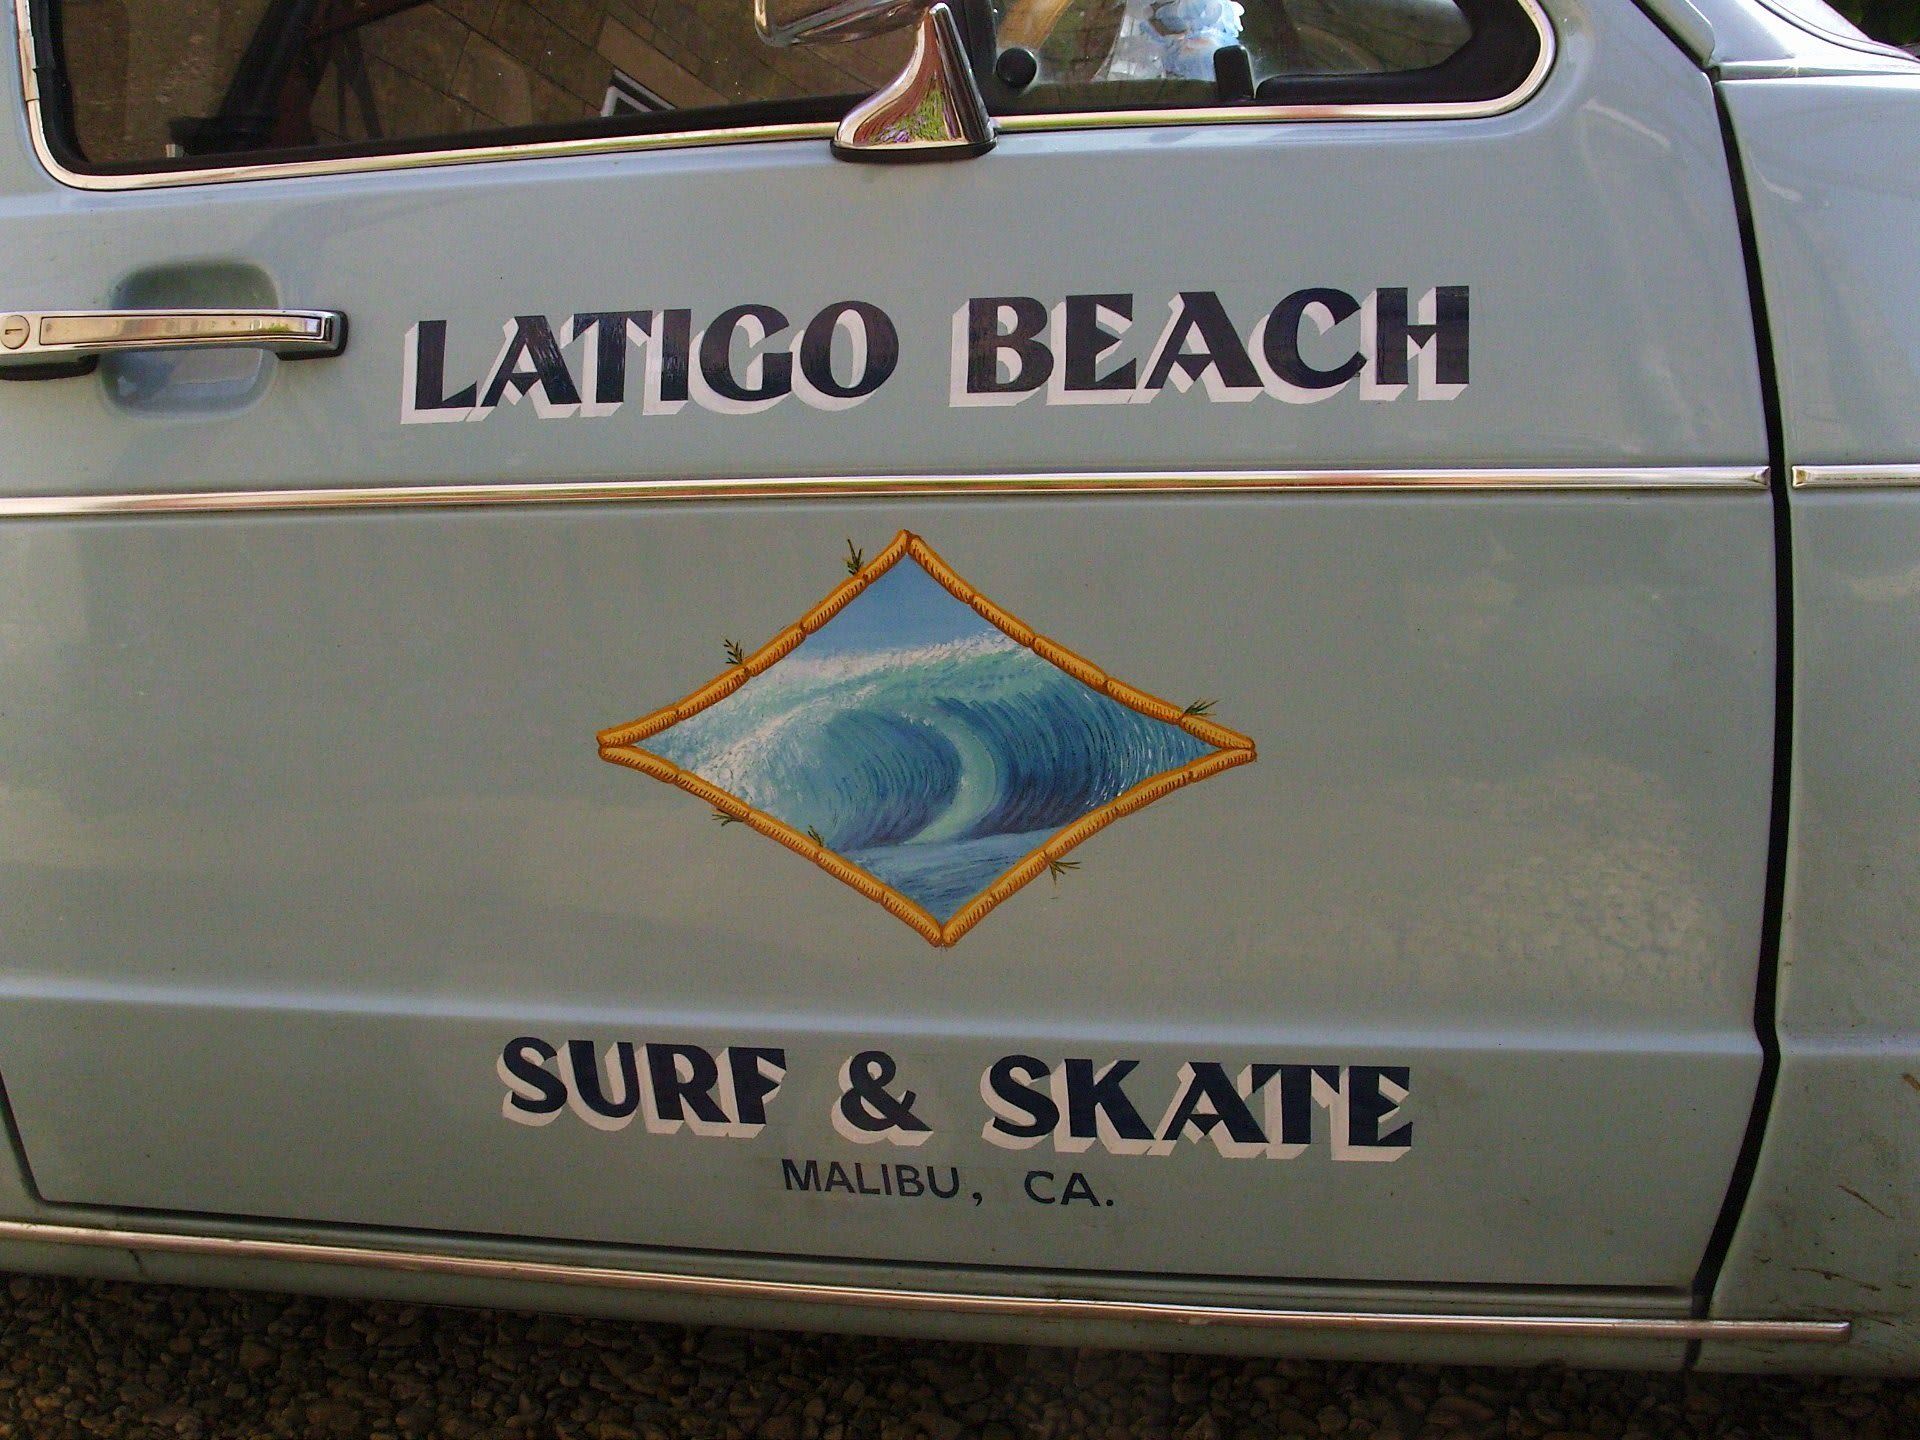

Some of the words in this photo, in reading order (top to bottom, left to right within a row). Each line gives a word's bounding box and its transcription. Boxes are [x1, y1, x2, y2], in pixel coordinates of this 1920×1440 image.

[401, 300, 899, 424] LATIGO
[949, 285, 1469, 407] BEACH
[497, 1036, 787, 1138] SURF
[831, 1050, 933, 1146] &
[980, 1055, 1412, 1161] SKATE
[782, 1158, 983, 1206] MALIBU,
[1023, 1170, 1114, 1207] CA.
